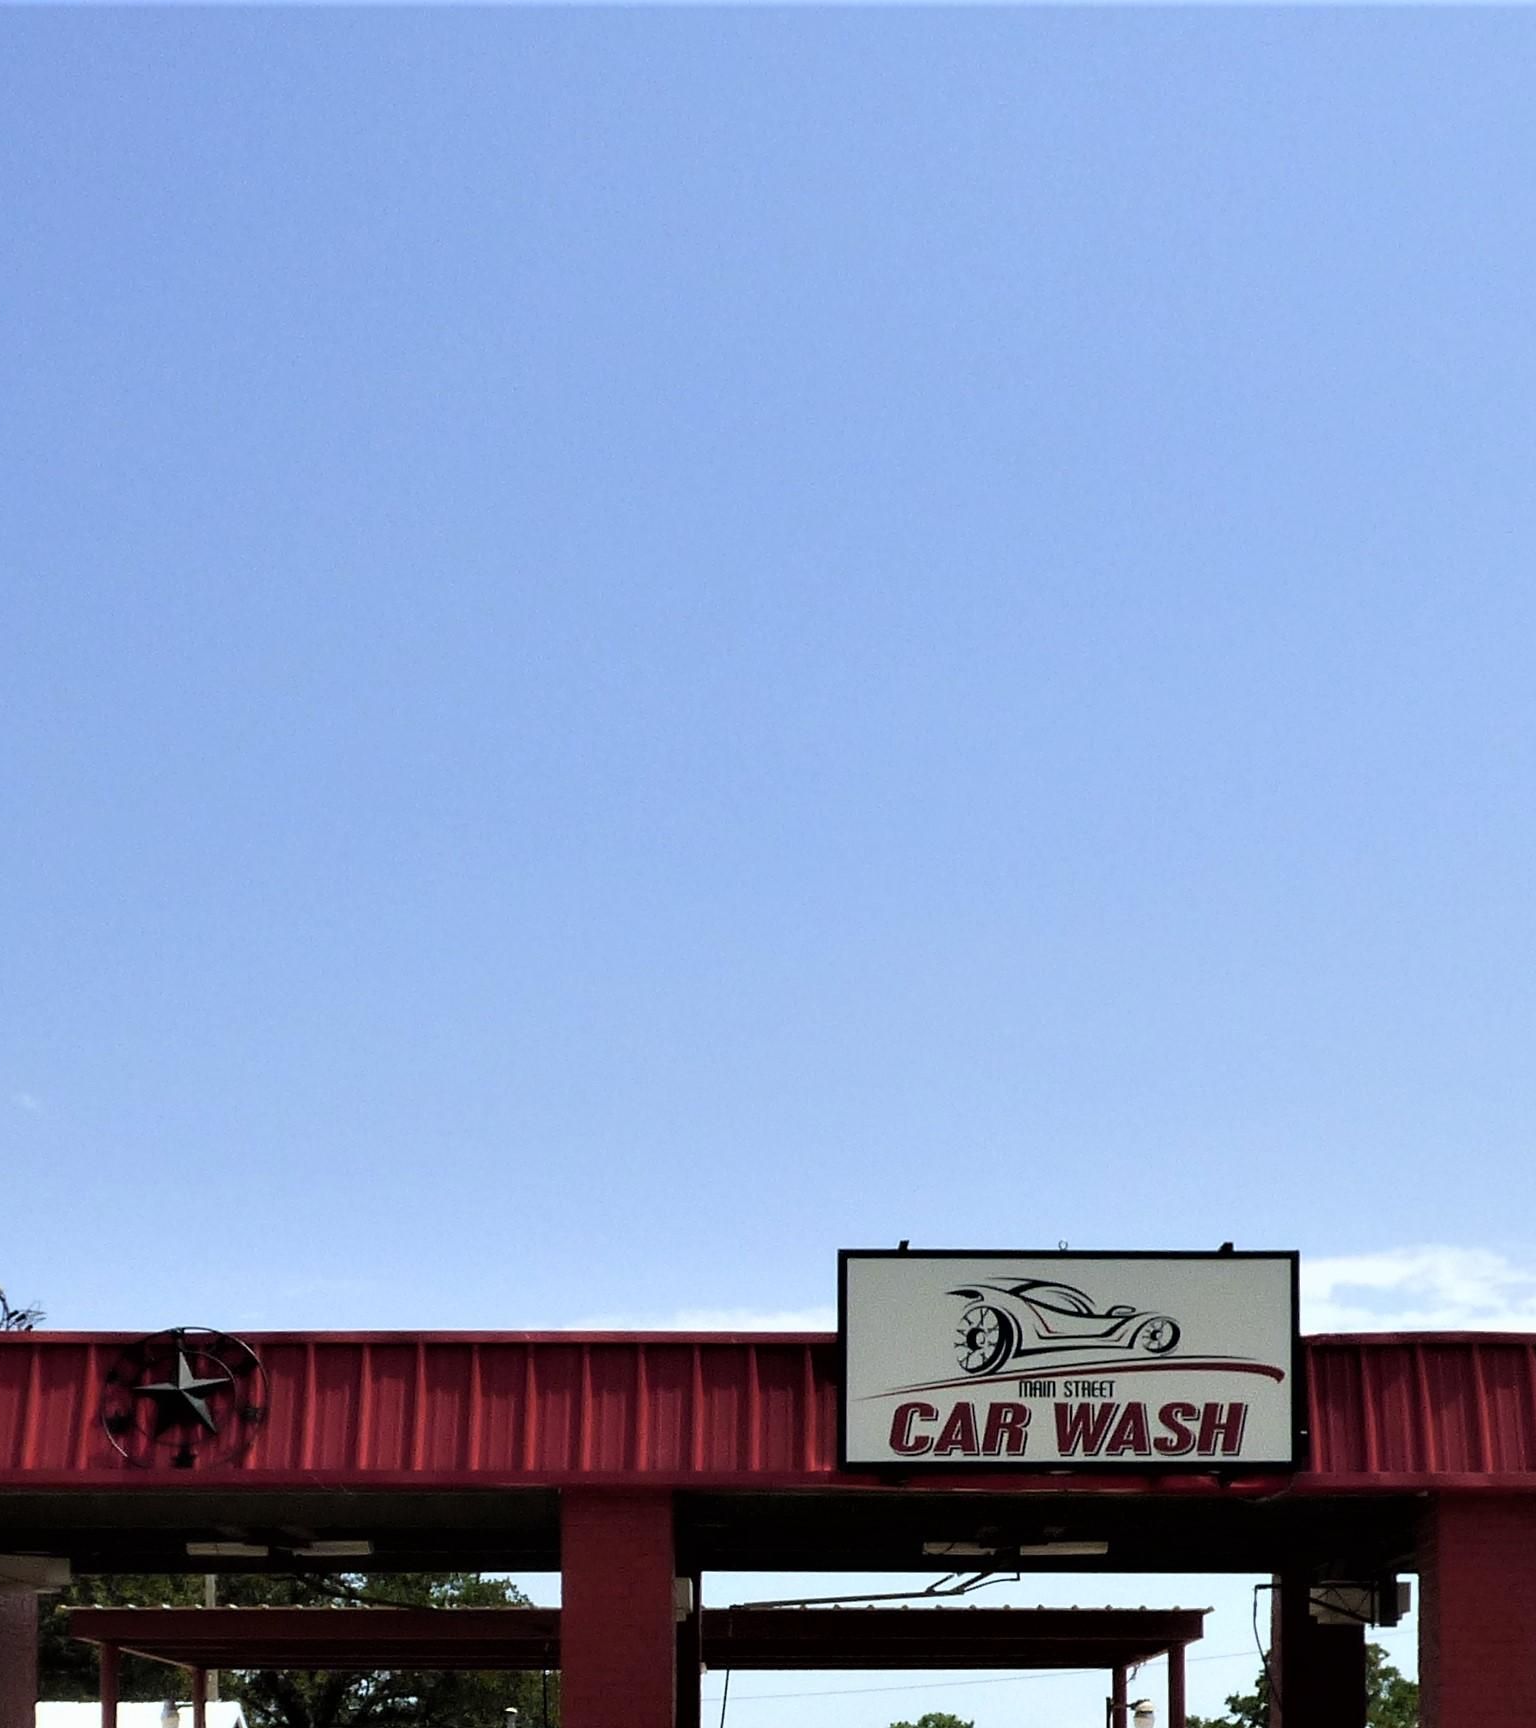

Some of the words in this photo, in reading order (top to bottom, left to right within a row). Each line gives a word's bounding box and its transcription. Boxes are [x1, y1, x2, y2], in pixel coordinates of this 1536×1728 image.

[1018, 1380, 1056, 1398] MAIN
[1063, 1380, 1116, 1398] STREET
[888, 1401, 1032, 1457] CAR
[1054, 1401, 1248, 1457] WASH
